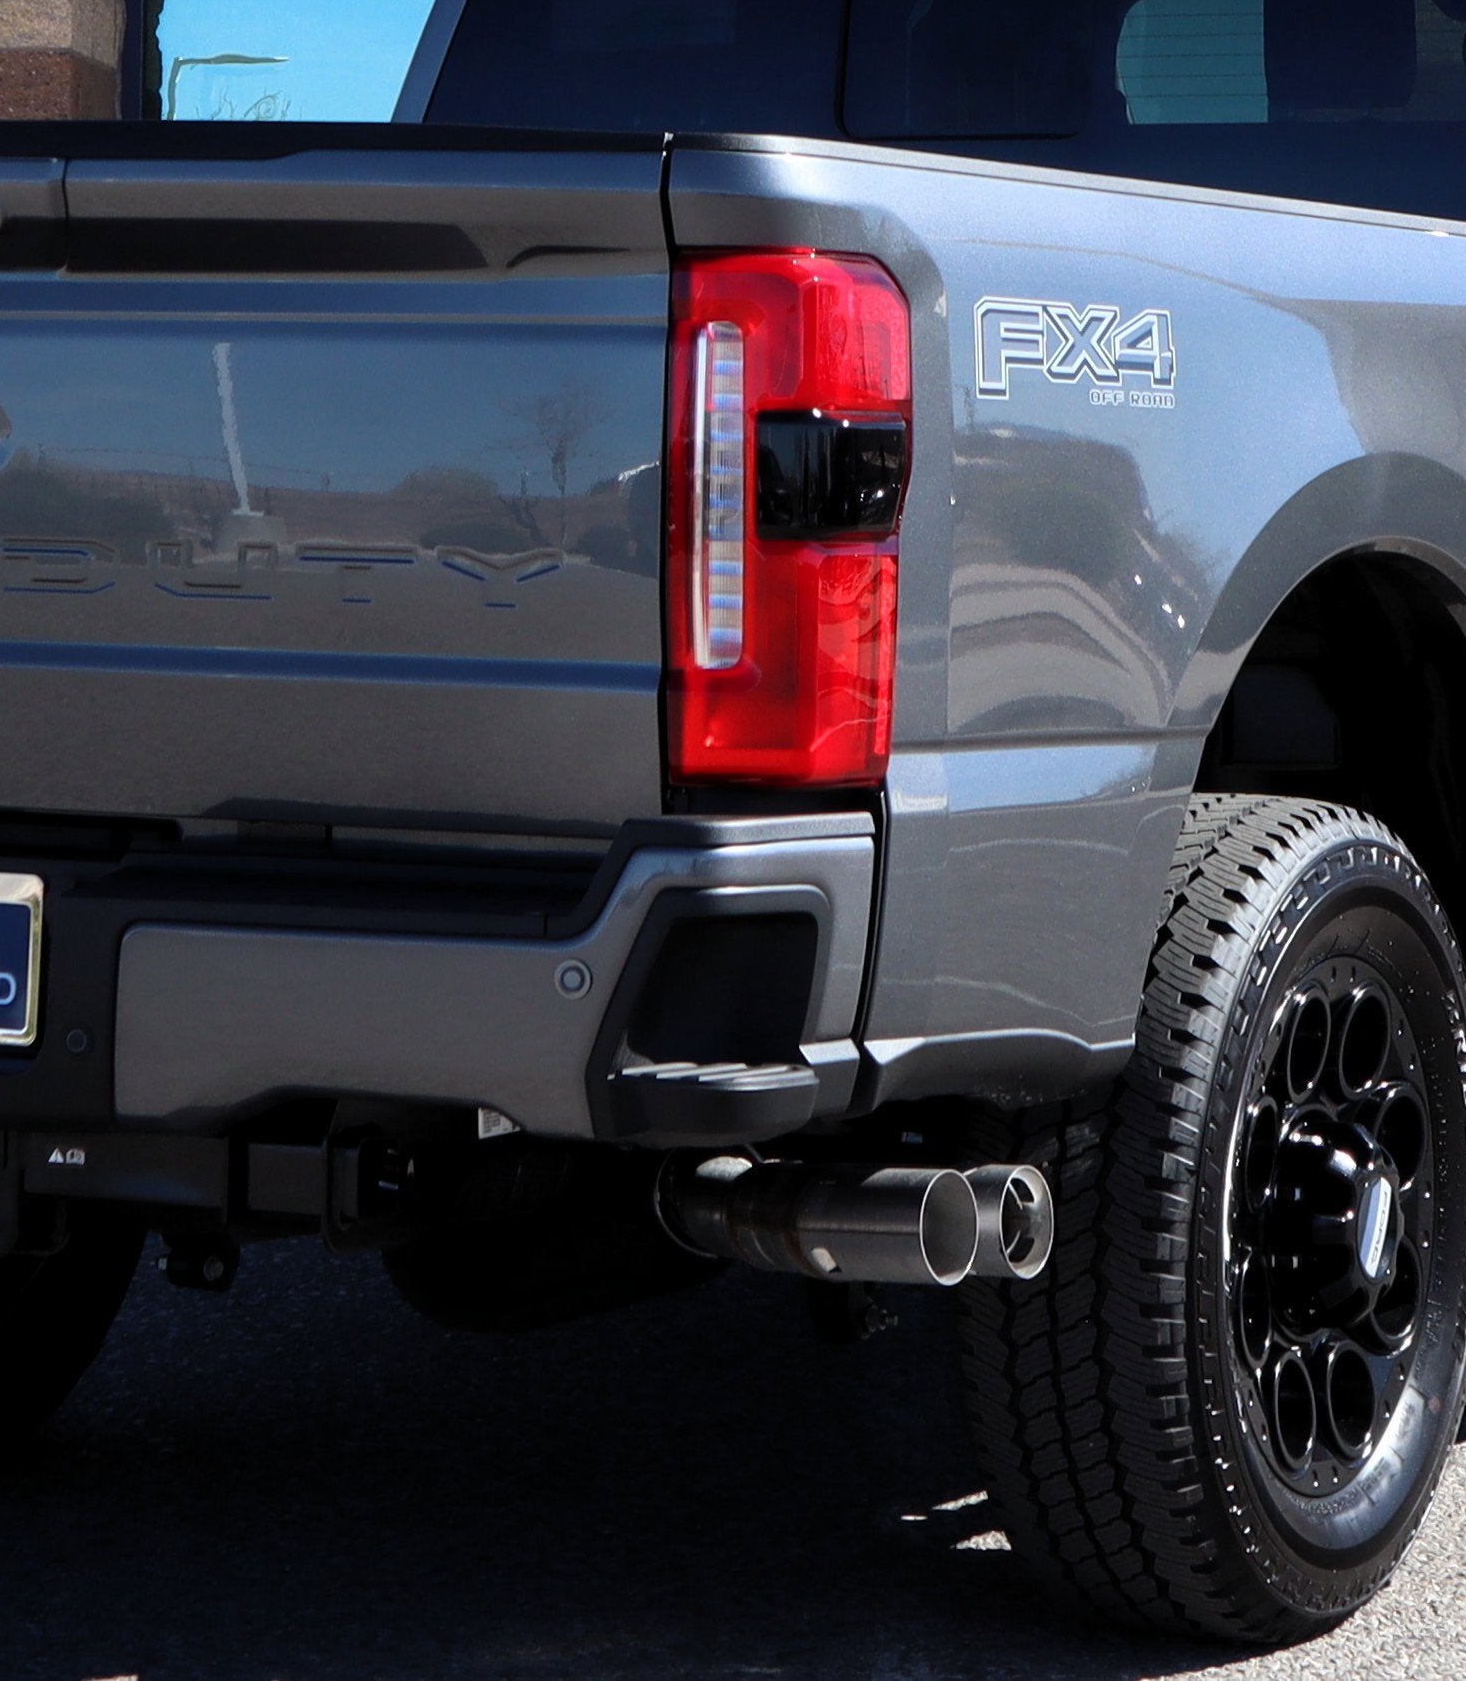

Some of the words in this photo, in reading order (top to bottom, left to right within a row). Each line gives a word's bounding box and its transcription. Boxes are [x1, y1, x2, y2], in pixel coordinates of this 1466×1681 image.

[973, 295, 1176, 400] FX4
[1089, 389, 1125, 406] OFF
[1129, 390, 1176, 409] ROAD
